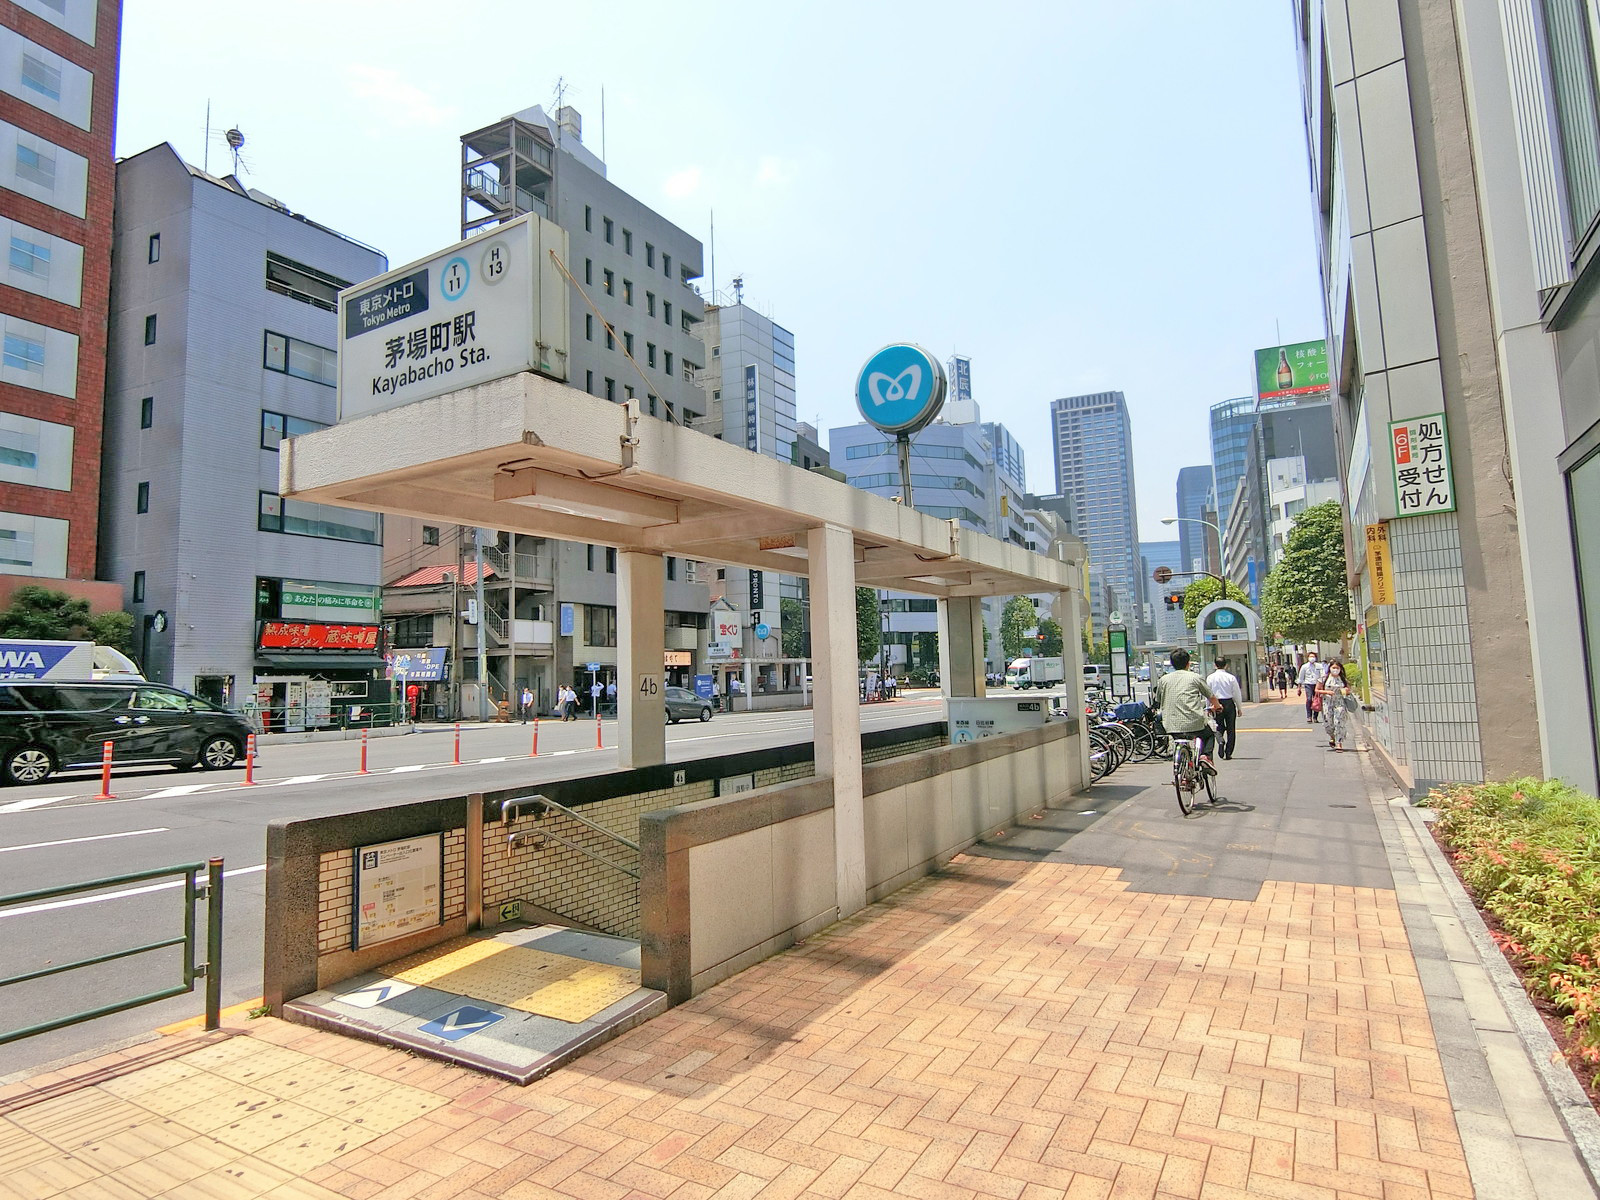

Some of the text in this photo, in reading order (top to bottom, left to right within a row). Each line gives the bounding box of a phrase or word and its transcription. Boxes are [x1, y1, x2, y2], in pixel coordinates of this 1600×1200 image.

[492, 248, 499, 261] H
[452, 265, 458, 276] T
[489, 261, 503, 277] 13
[449, 277, 461, 292] 11
[359, 281, 414, 316] 東京メトロ
[362, 302, 411, 328] Tokyo Metro
[385, 310, 476, 369] 茅場町駅
[372, 347, 490, 395] Kayabacho Sta.
[1395, 433, 1408, 458] 6F
[1418, 421, 1448, 507] 処方せん
[1398, 467, 1422, 509] 受付
[1366, 527, 1376, 543] 内科
[1377, 526, 1387, 542] 外科
[640, 678, 658, 696] 4b
[1029, 703, 1040, 711] 4b
